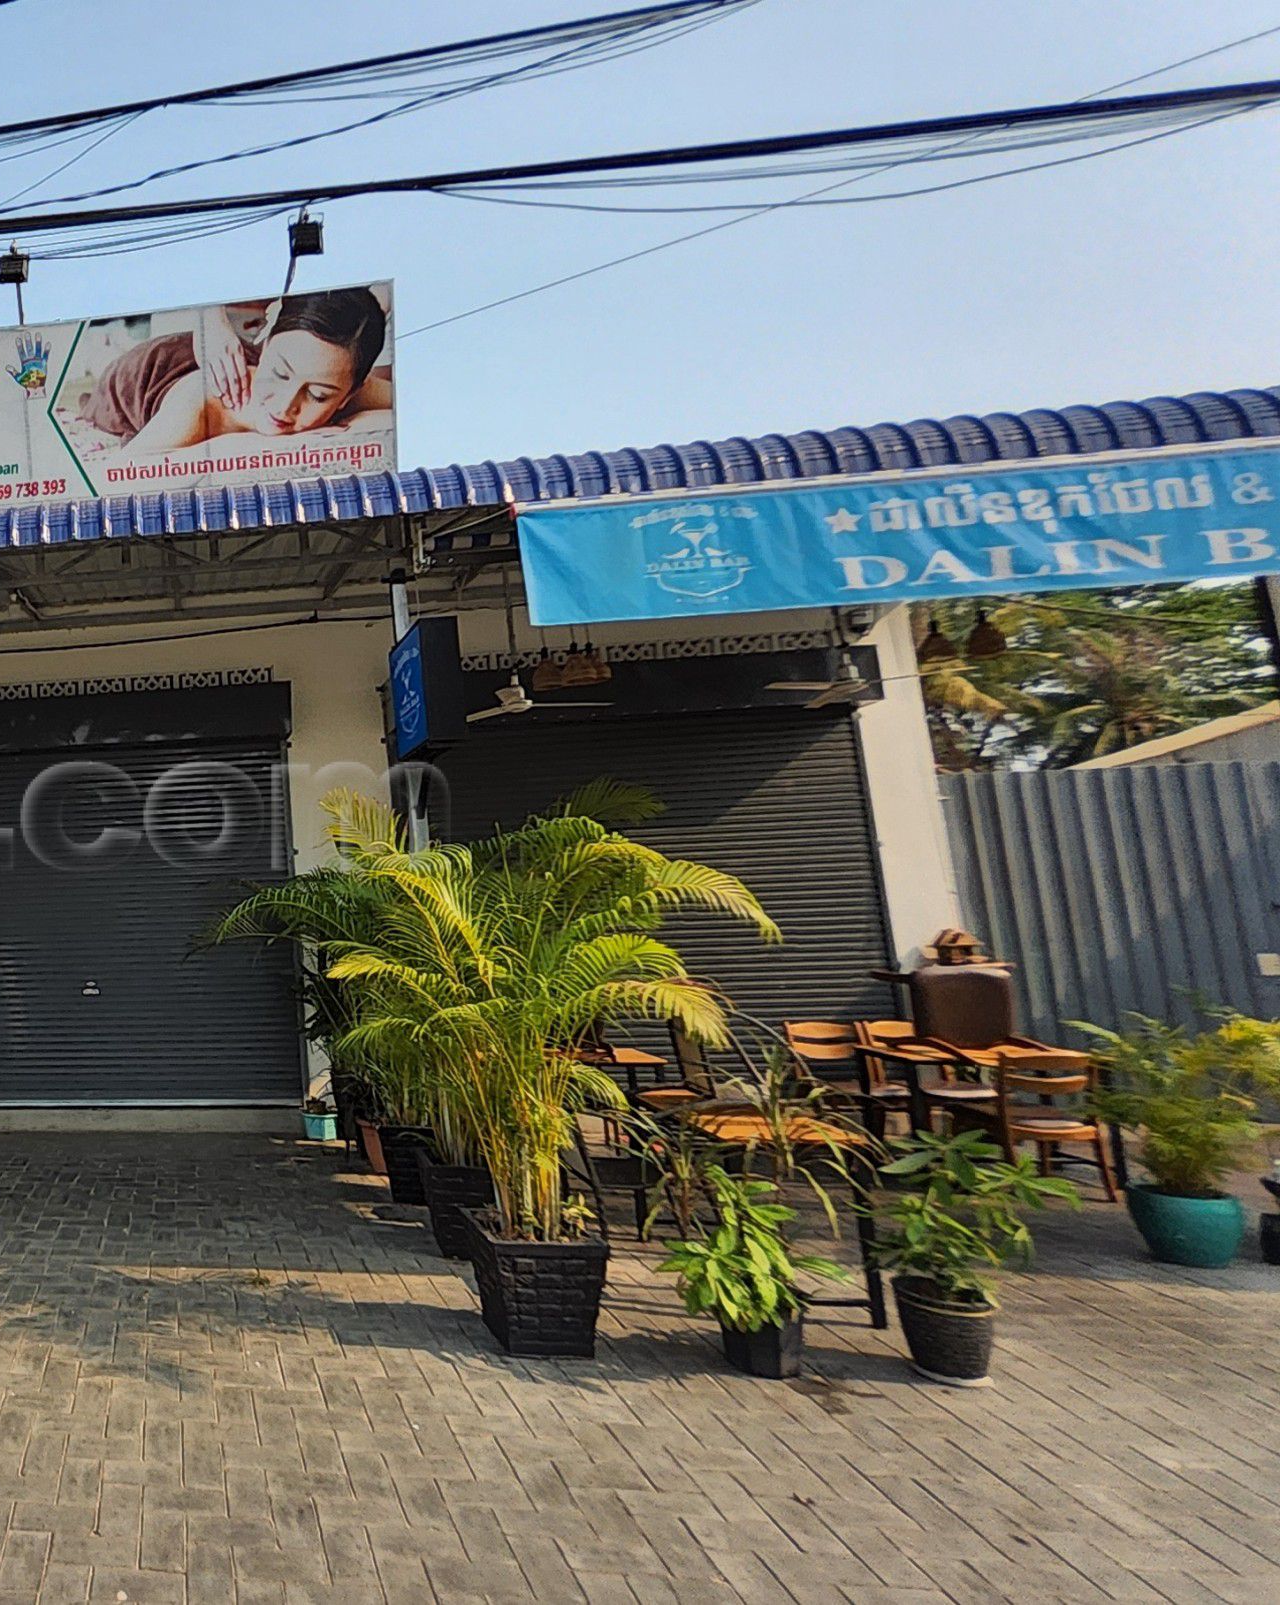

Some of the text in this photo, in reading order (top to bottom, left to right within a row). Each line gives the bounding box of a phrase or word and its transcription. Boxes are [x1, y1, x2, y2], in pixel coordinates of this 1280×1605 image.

[15, 482, 39, 498] 738
[42, 479, 66, 495] 393
[1231, 472, 1275, 504] &
[832, 534, 1167, 591] DALIN
